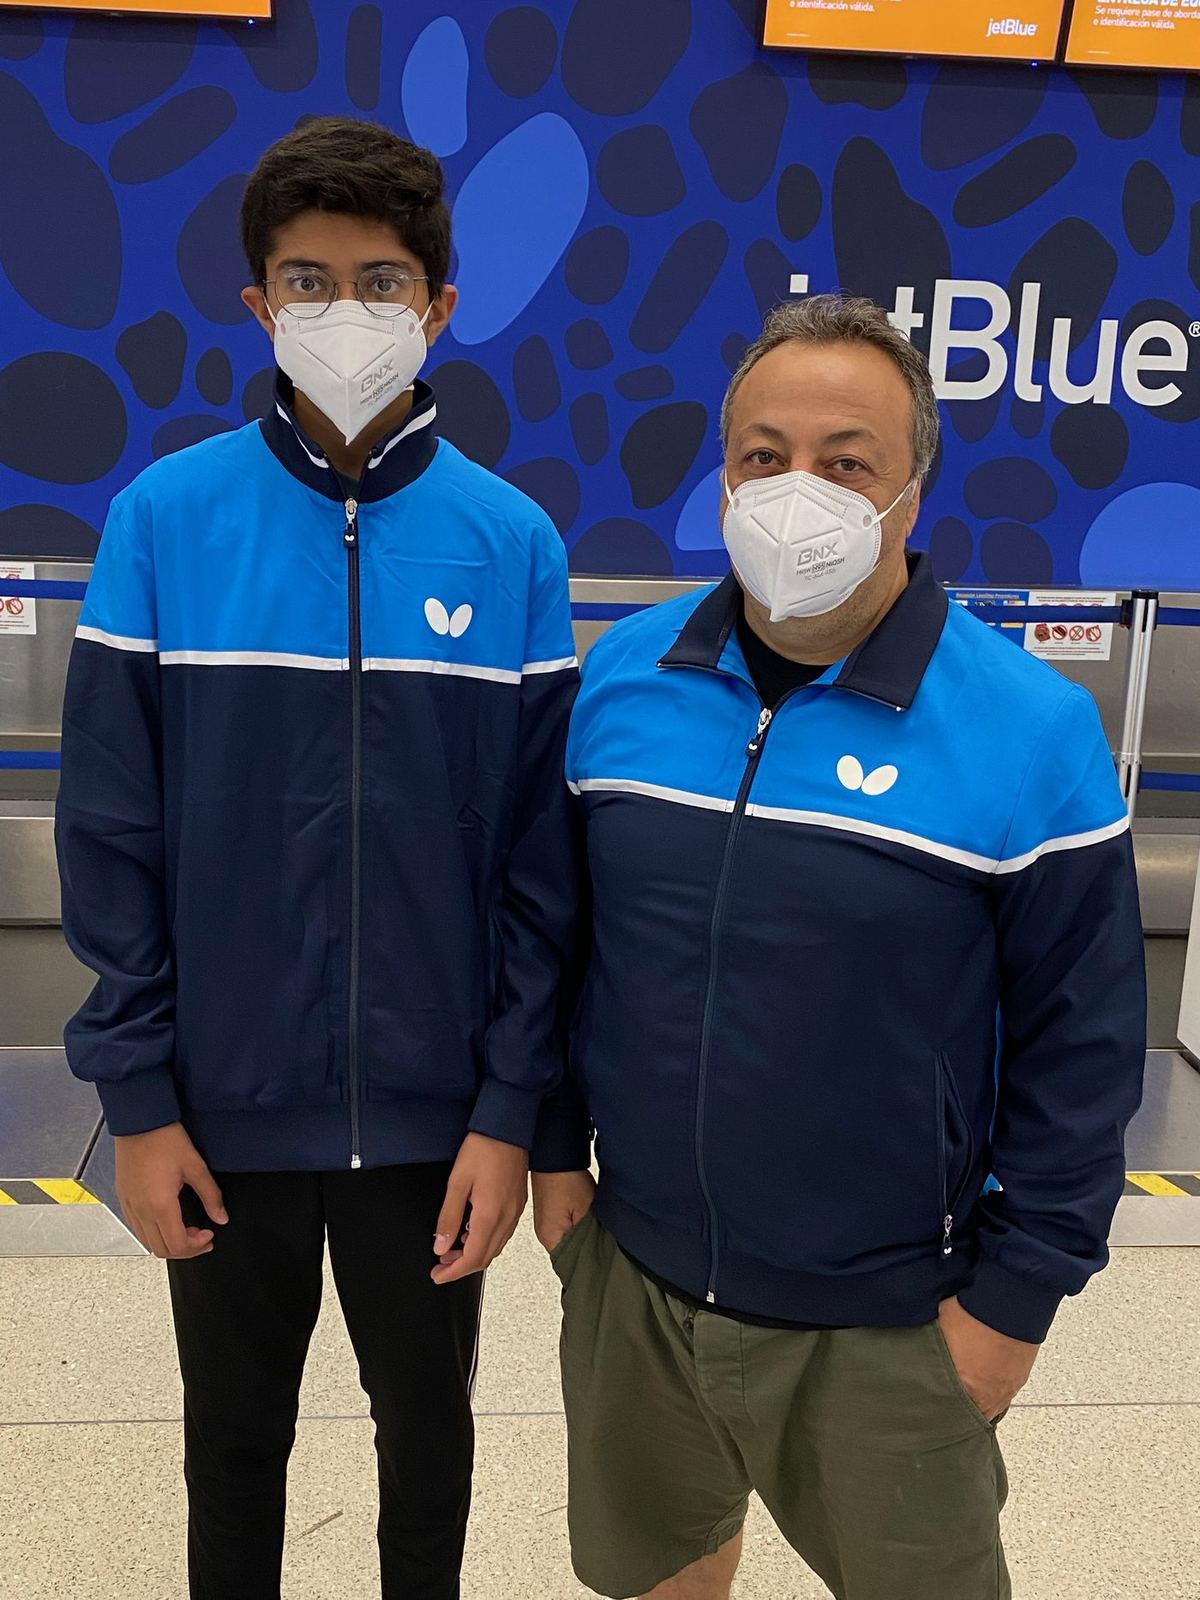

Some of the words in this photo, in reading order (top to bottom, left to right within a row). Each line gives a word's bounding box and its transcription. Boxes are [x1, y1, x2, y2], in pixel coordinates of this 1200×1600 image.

[1095, 5, 1105, 14] Se
[1107, 7, 1140, 17] requiere
[1142, 9, 1161, 18] pase
[1162, 9, 1172, 17] de
[985, 18, 1037, 37] jetBlue
[789, 274, 1189, 406] tBlue
[361, 358, 393, 393] BNX
[797, 541, 838, 566] BNX
